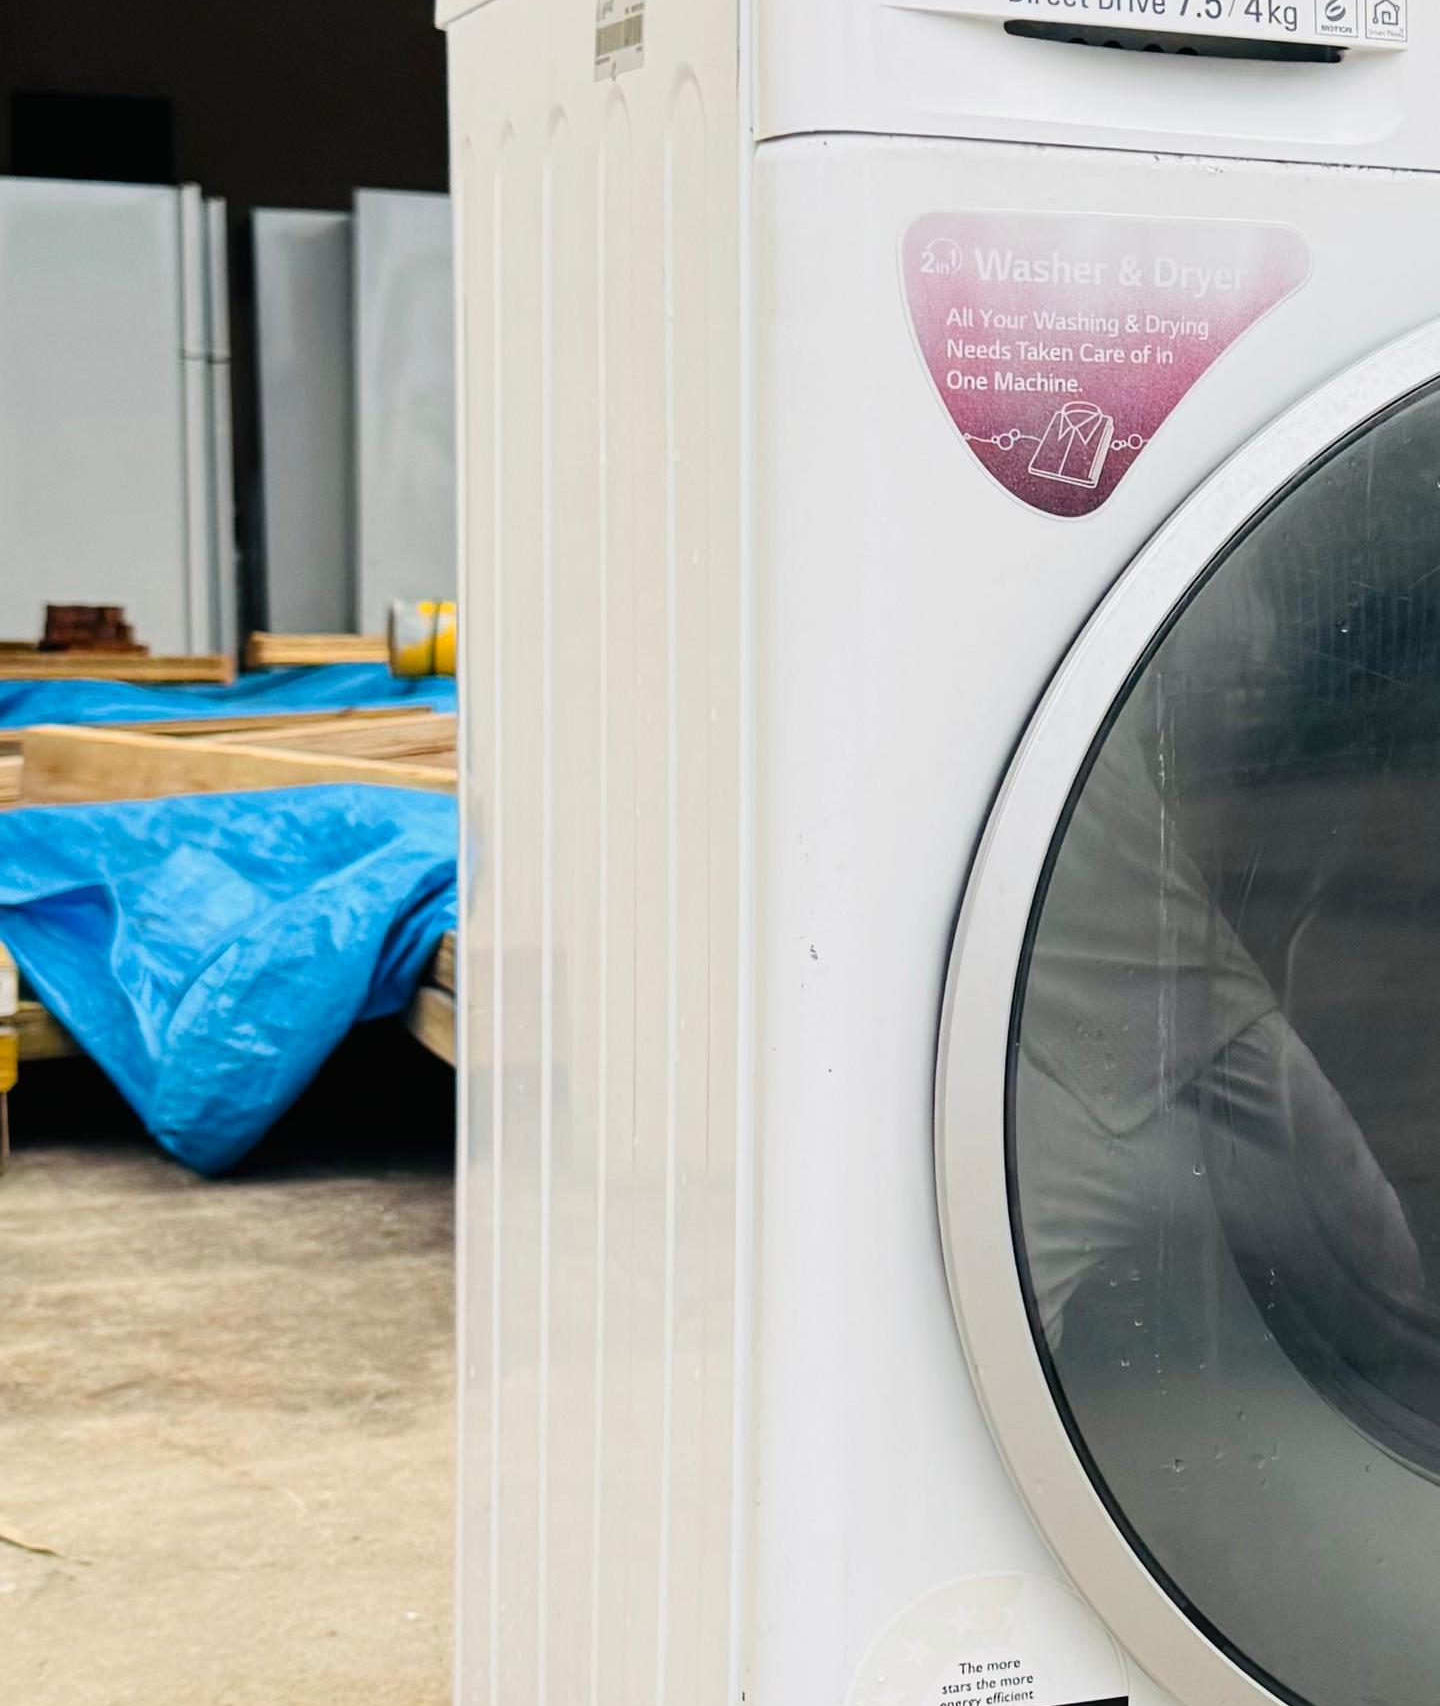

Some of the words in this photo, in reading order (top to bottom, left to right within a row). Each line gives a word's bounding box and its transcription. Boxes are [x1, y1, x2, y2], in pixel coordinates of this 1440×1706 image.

[973, 247, 1108, 285] Washer
[1119, 255, 1143, 287] &
[1155, 257, 1248, 297] Dryer
[946, 307, 974, 327] All
[981, 309, 1028, 329] Your
[1034, 311, 1119, 337] Washing
[1125, 314, 1140, 333] &
[1146, 315, 1209, 341] Drying
[947, 339, 1012, 360] Needs
[1016, 341, 1073, 361] Taken
[1081, 344, 1125, 363] Care
[1131, 345, 1152, 364] of
[947, 370, 988, 390] One
[994, 371, 1083, 392] Machine.
[959, 1662, 982, 1674] The
[987, 1660, 1020, 1671] more
[942, 1683, 971, 1694] stars
[977, 1678, 996, 1690] the
[1000, 1675, 1033, 1687] more
[986, 1691, 1034, 1704] efficient
